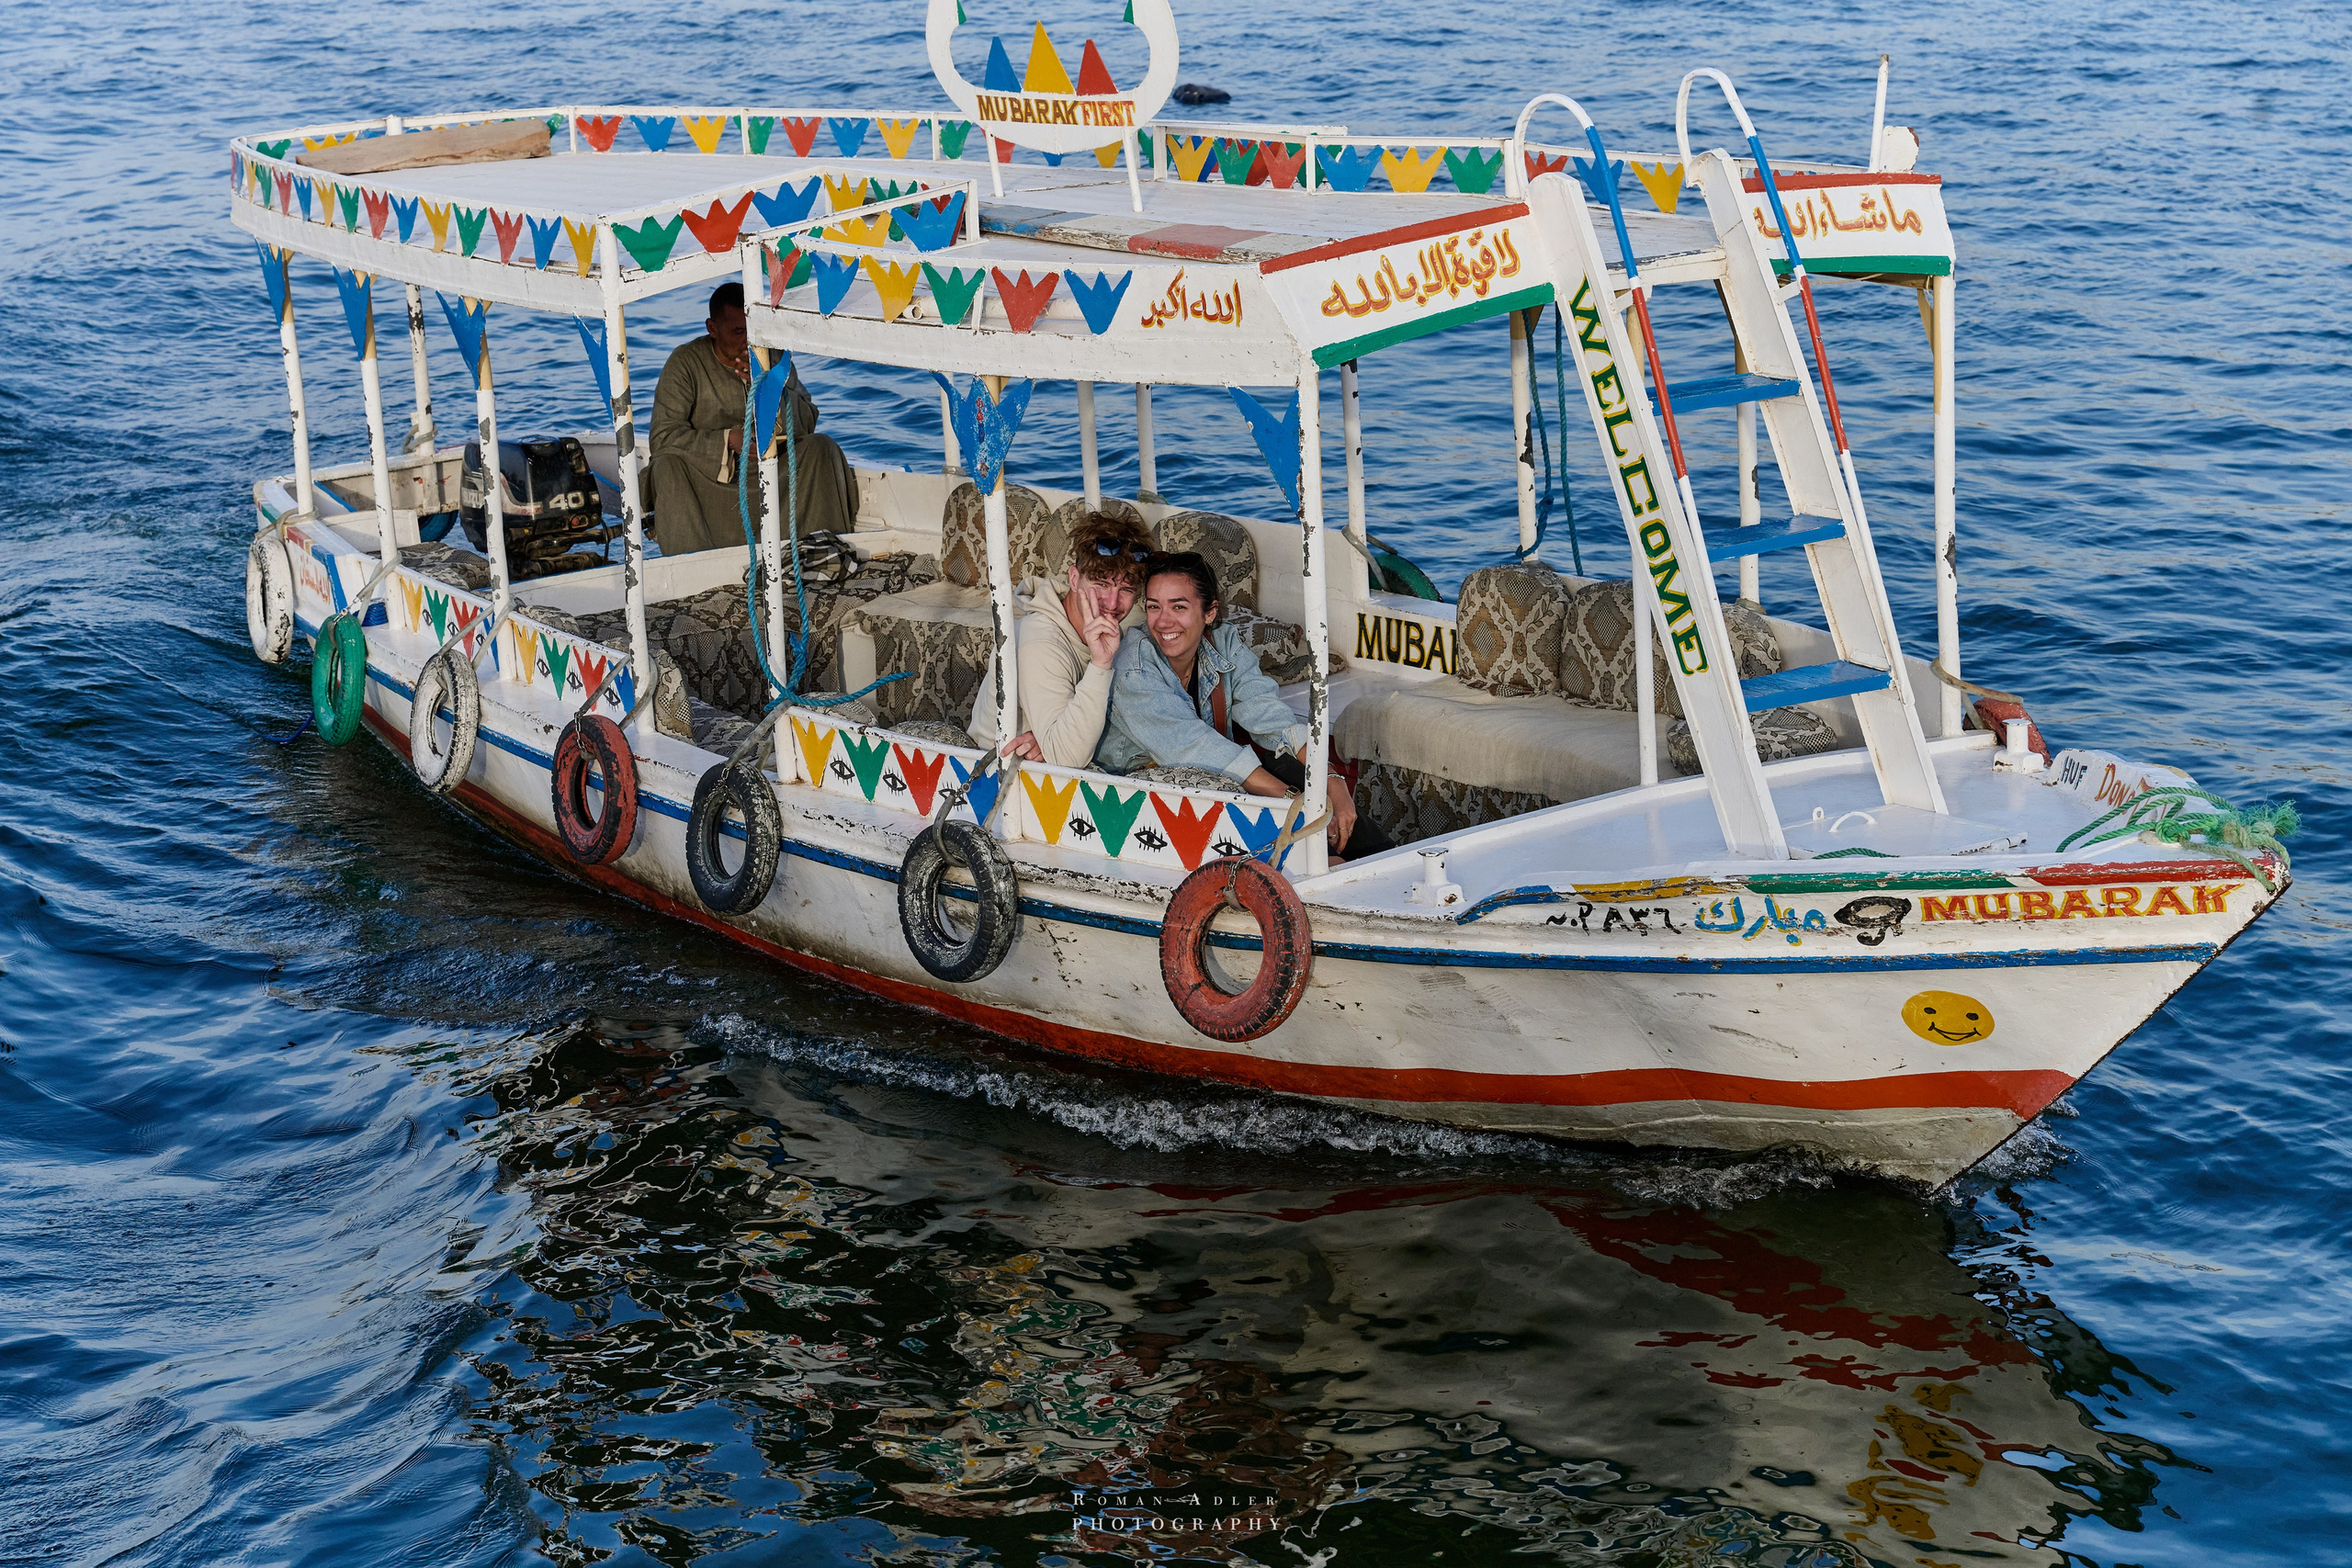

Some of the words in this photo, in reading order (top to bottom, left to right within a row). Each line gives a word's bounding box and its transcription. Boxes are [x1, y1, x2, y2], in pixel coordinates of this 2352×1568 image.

[976, 95, 1080, 125] MUBARAK
[1080, 100, 1136, 127] FIRST
[1190, 278, 1243, 328] الله
[1569, 276, 1711, 678] WELCOME
[548, 491, 585, 511] 40
[1694, 893, 1828, 946] مبارك
[1918, 883, 2245, 922] MUBARAK
